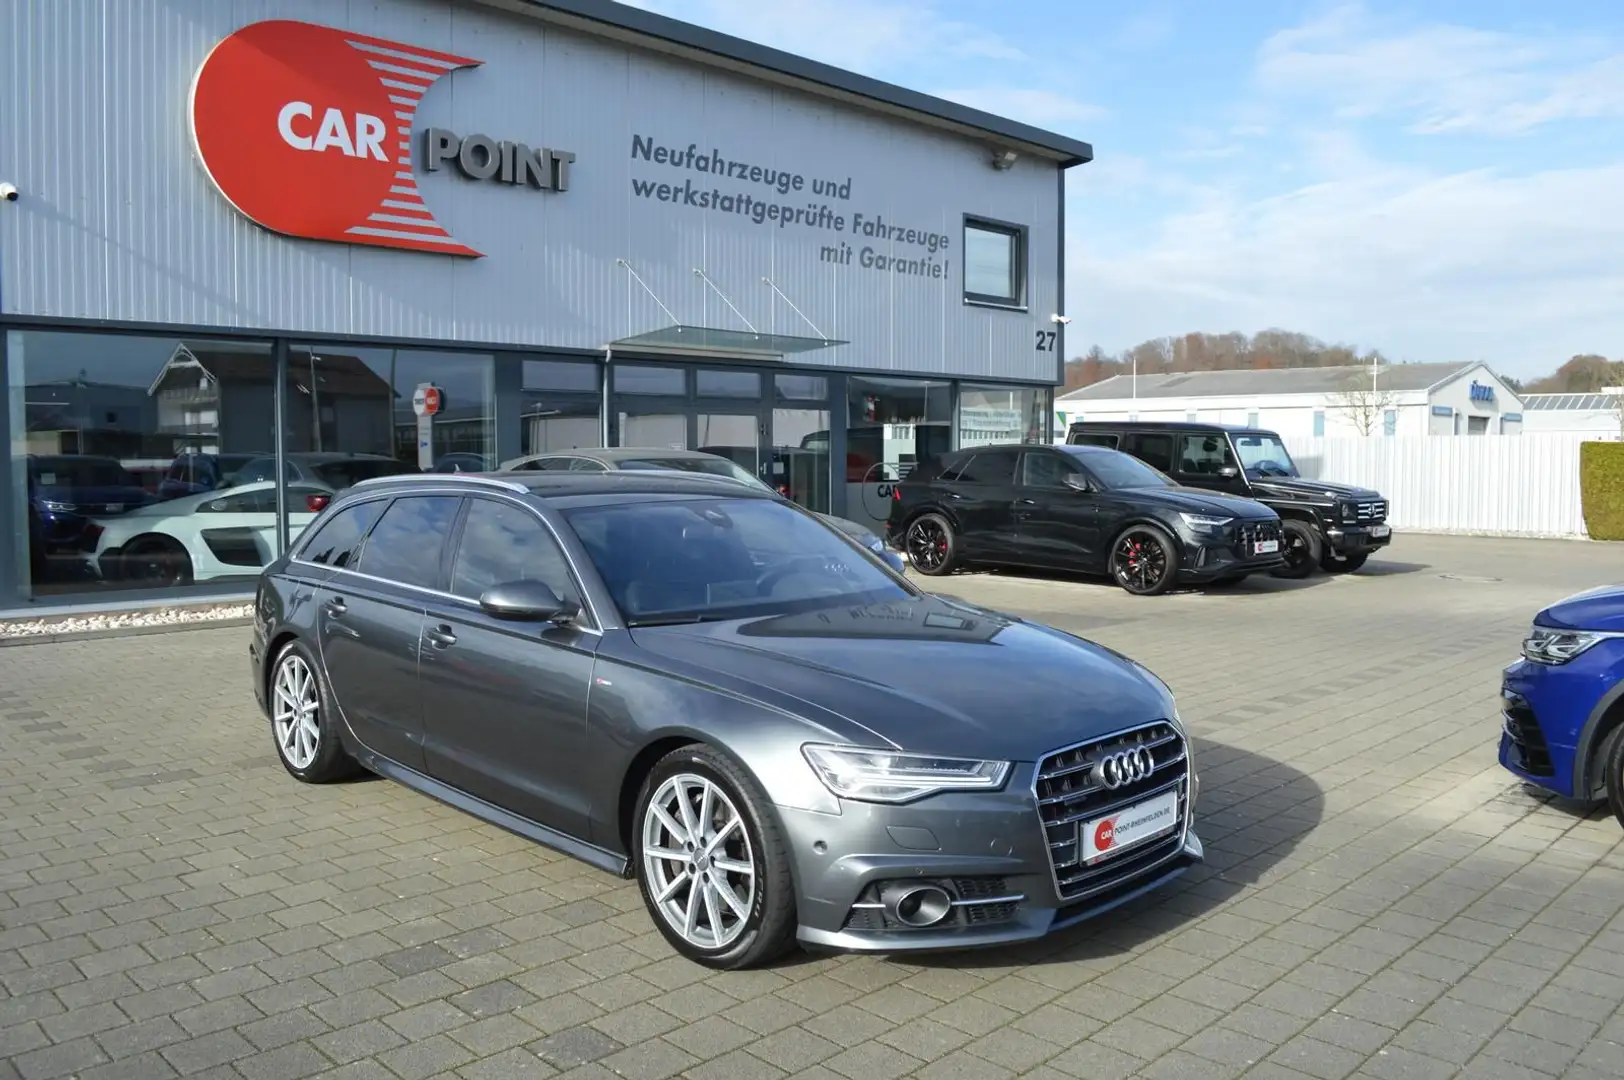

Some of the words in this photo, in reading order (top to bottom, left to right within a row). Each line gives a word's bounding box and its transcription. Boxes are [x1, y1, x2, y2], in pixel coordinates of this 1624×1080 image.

[277, 101, 389, 162] CAR
[425, 127, 576, 192] POINT
[631, 134, 804, 195] Neufahrzeuge
[812, 177, 851, 200] und
[632, 177, 845, 232] werkstattgeprüfte
[852, 213, 949, 252] Fahrzeuge
[820, 242, 852, 265] mit
[860, 248, 949, 280] Garantie!
[1036, 330, 1056, 351] 27
[1101, 828, 1113, 840] CAR
